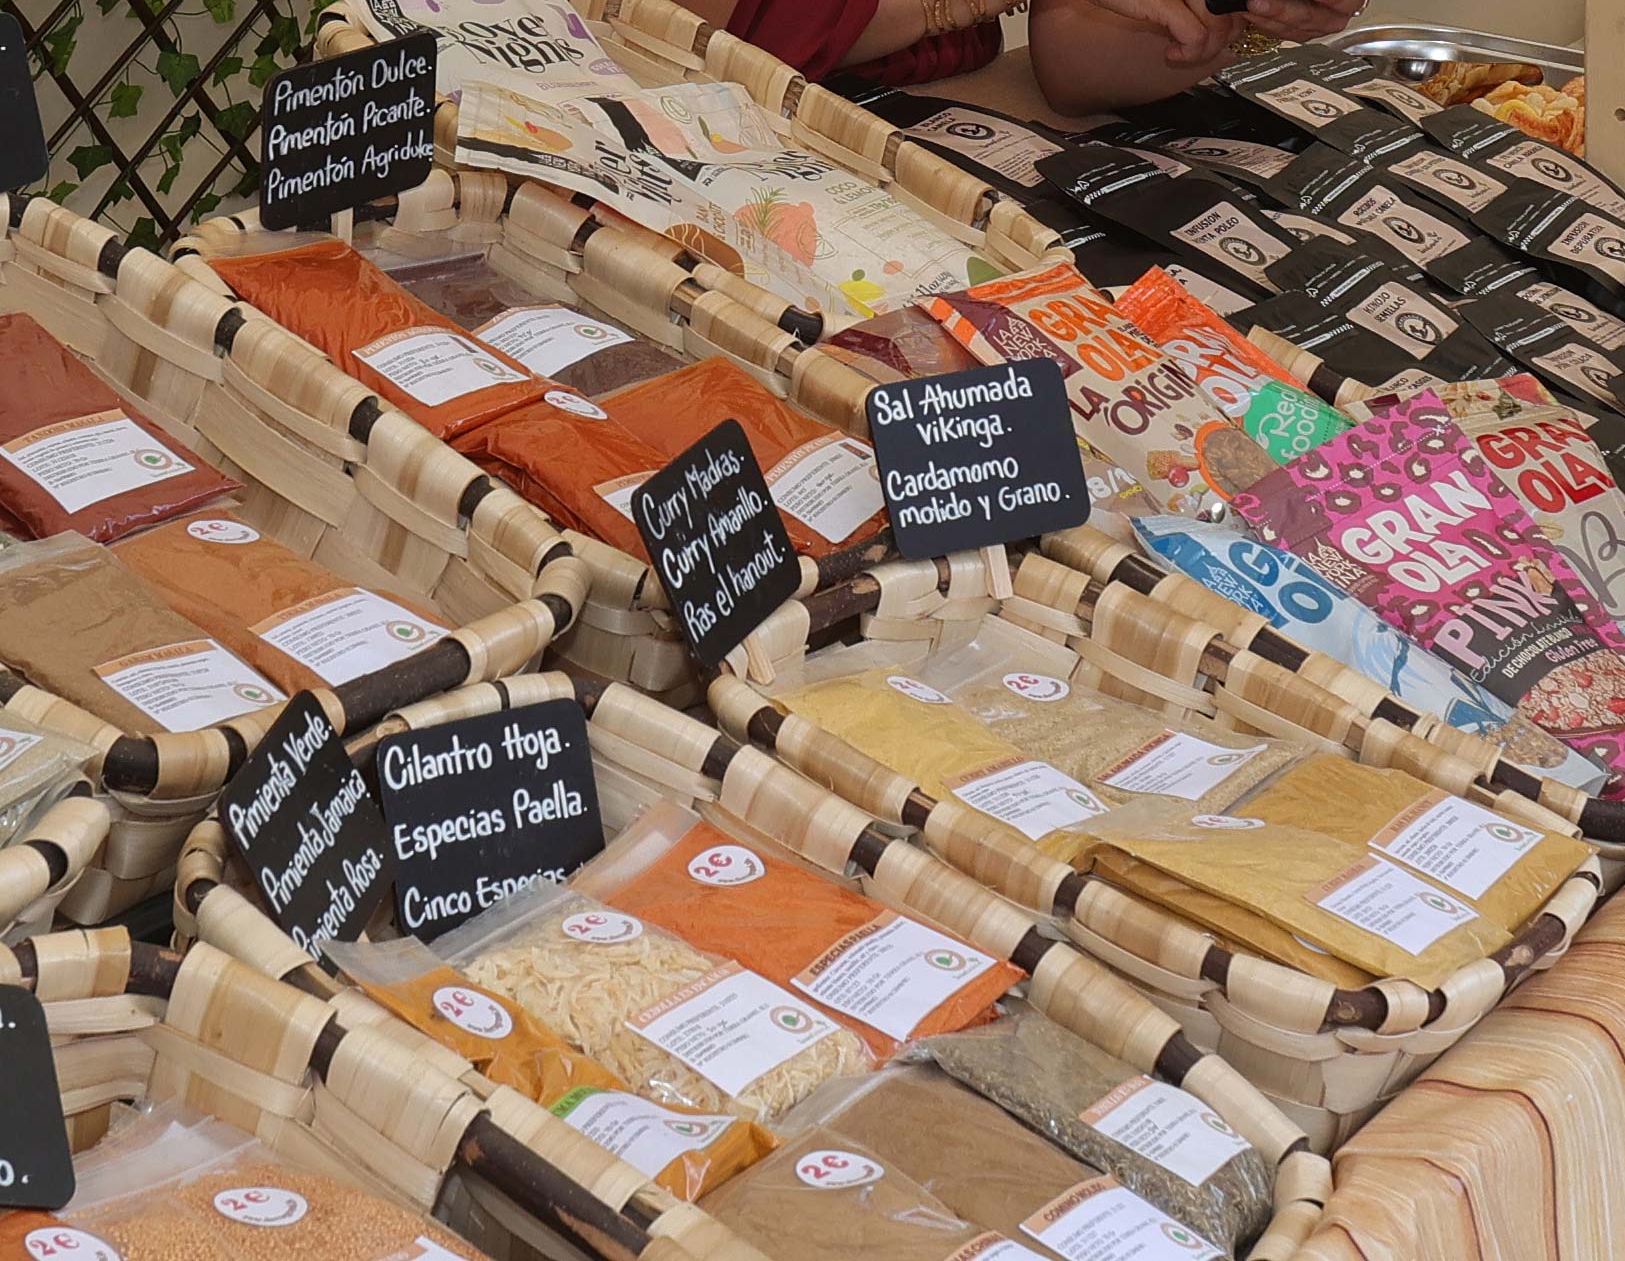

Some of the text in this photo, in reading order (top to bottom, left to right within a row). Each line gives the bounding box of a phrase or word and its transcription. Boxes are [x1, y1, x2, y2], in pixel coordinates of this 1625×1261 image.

[273, 49, 433, 117] Pimentón Dulce.
[268, 86, 431, 161] Pimentón Picante.
[267, 154, 355, 205] Pimentón
[825, 181, 858, 195] COCO
[1184, 211, 1222, 237] INFUSION
[1213, 216, 1240, 235] POLEO
[1363, 291, 1391, 315] HINOJO
[1374, 296, 1407, 324] SEMILLAS
[1004, 327, 1037, 356] NEW
[874, 366, 1033, 426] Sal Ahumada
[1069, 385, 1112, 423] LA
[916, 411, 1013, 448] vikinga.
[641, 448, 746, 540] Curry Madras.
[886, 456, 1019, 502] Cardamomo
[1517, 451, 1617, 514] OLA
[898, 481, 1071, 529] molido y Grano.
[1341, 470, 1494, 566] GRAN
[661, 532, 717, 591] Curry
[1311, 550, 1345, 573] NEW
[1326, 559, 1359, 581] YORK
[1336, 568, 1369, 589] INA
[1388, 539, 1493, 594] OLA
[683, 530, 787, 644] Ras el hanout.
[1434, 570, 1560, 671] PINK
[1545, 641, 1578, 665] Gluten
[1006, 674, 1040, 692] 2€
[384, 722, 571, 791] Cilantro Hoja.
[228, 710, 333, 850] Pimienta Verde.
[394, 779, 588, 860] Especias Paella.
[261, 817, 325, 914] Pimienta
[342, 845, 384, 899] Rosa.
[692, 851, 734, 880] 2€
[404, 885, 473, 929] Cinco
[566, 911, 610, 936] 2€
[809, 937, 853, 977] ESPECIAS
[441, 989, 476, 1017] 2€
[800, 1150, 851, 1181] 2€
[220, 1189, 271, 1213] 2€
[29, 1232, 80, 1257] 2€
